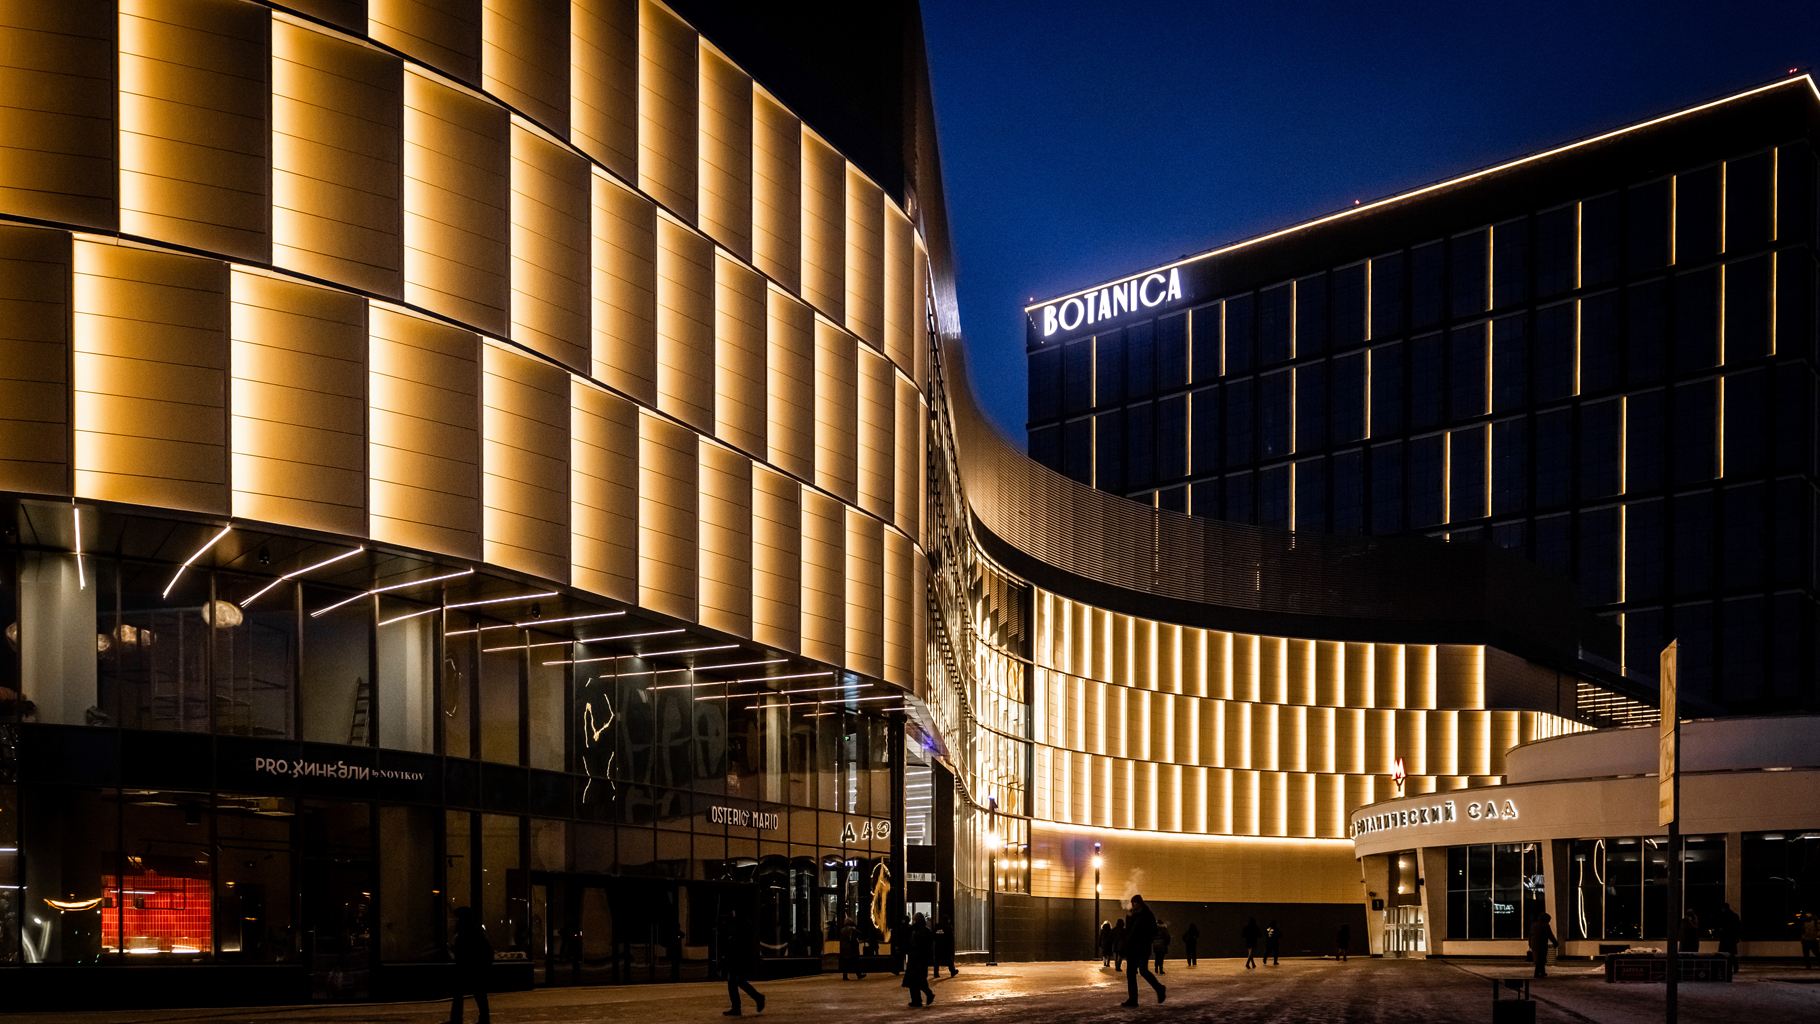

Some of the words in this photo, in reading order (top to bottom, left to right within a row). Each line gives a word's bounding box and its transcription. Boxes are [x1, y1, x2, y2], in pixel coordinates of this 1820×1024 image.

[1043, 267, 1182, 337] BOTANICA
[380, 769, 425, 781] NOVIKOV
[1467, 798, 1518, 821] САД
[752, 811, 779, 830] MARIO
